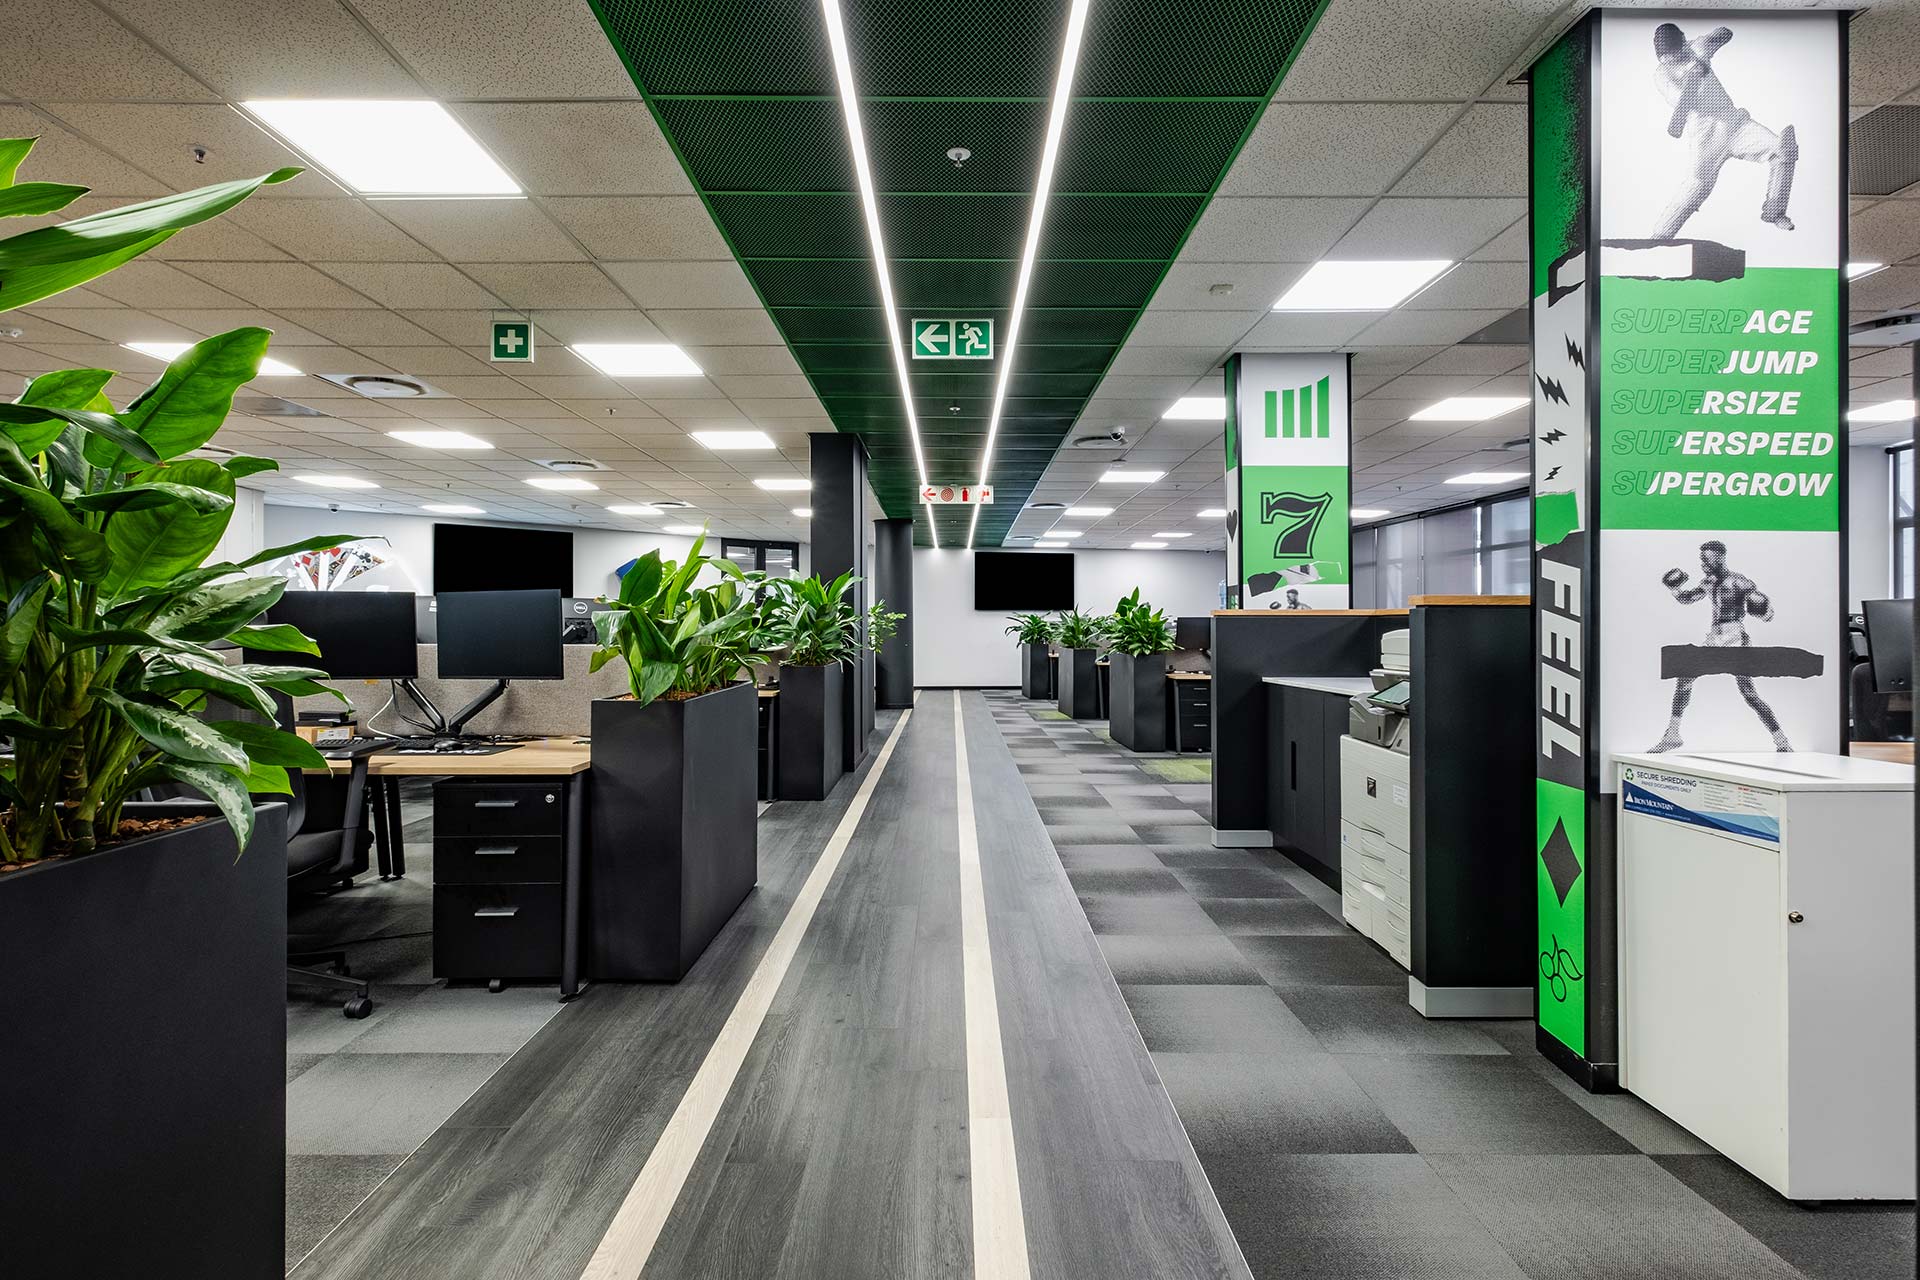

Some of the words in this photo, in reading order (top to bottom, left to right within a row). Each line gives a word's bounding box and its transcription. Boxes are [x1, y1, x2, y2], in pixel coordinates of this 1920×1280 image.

[1611, 309, 1813, 334] SUPERPACE
[1611, 349, 1818, 375] SUPERJUMP
[1611, 389, 1801, 415] SUPERSIZE
[1611, 430, 1834, 456] SUPERSPEED
[1611, 470, 1833, 497] SUPERGROW
[1261, 492, 1333, 559] 7
[1541, 558, 1581, 759] FEEL
[1637, 771, 1659, 781] SECURE
[1661, 775, 1697, 787] SHREDDING
